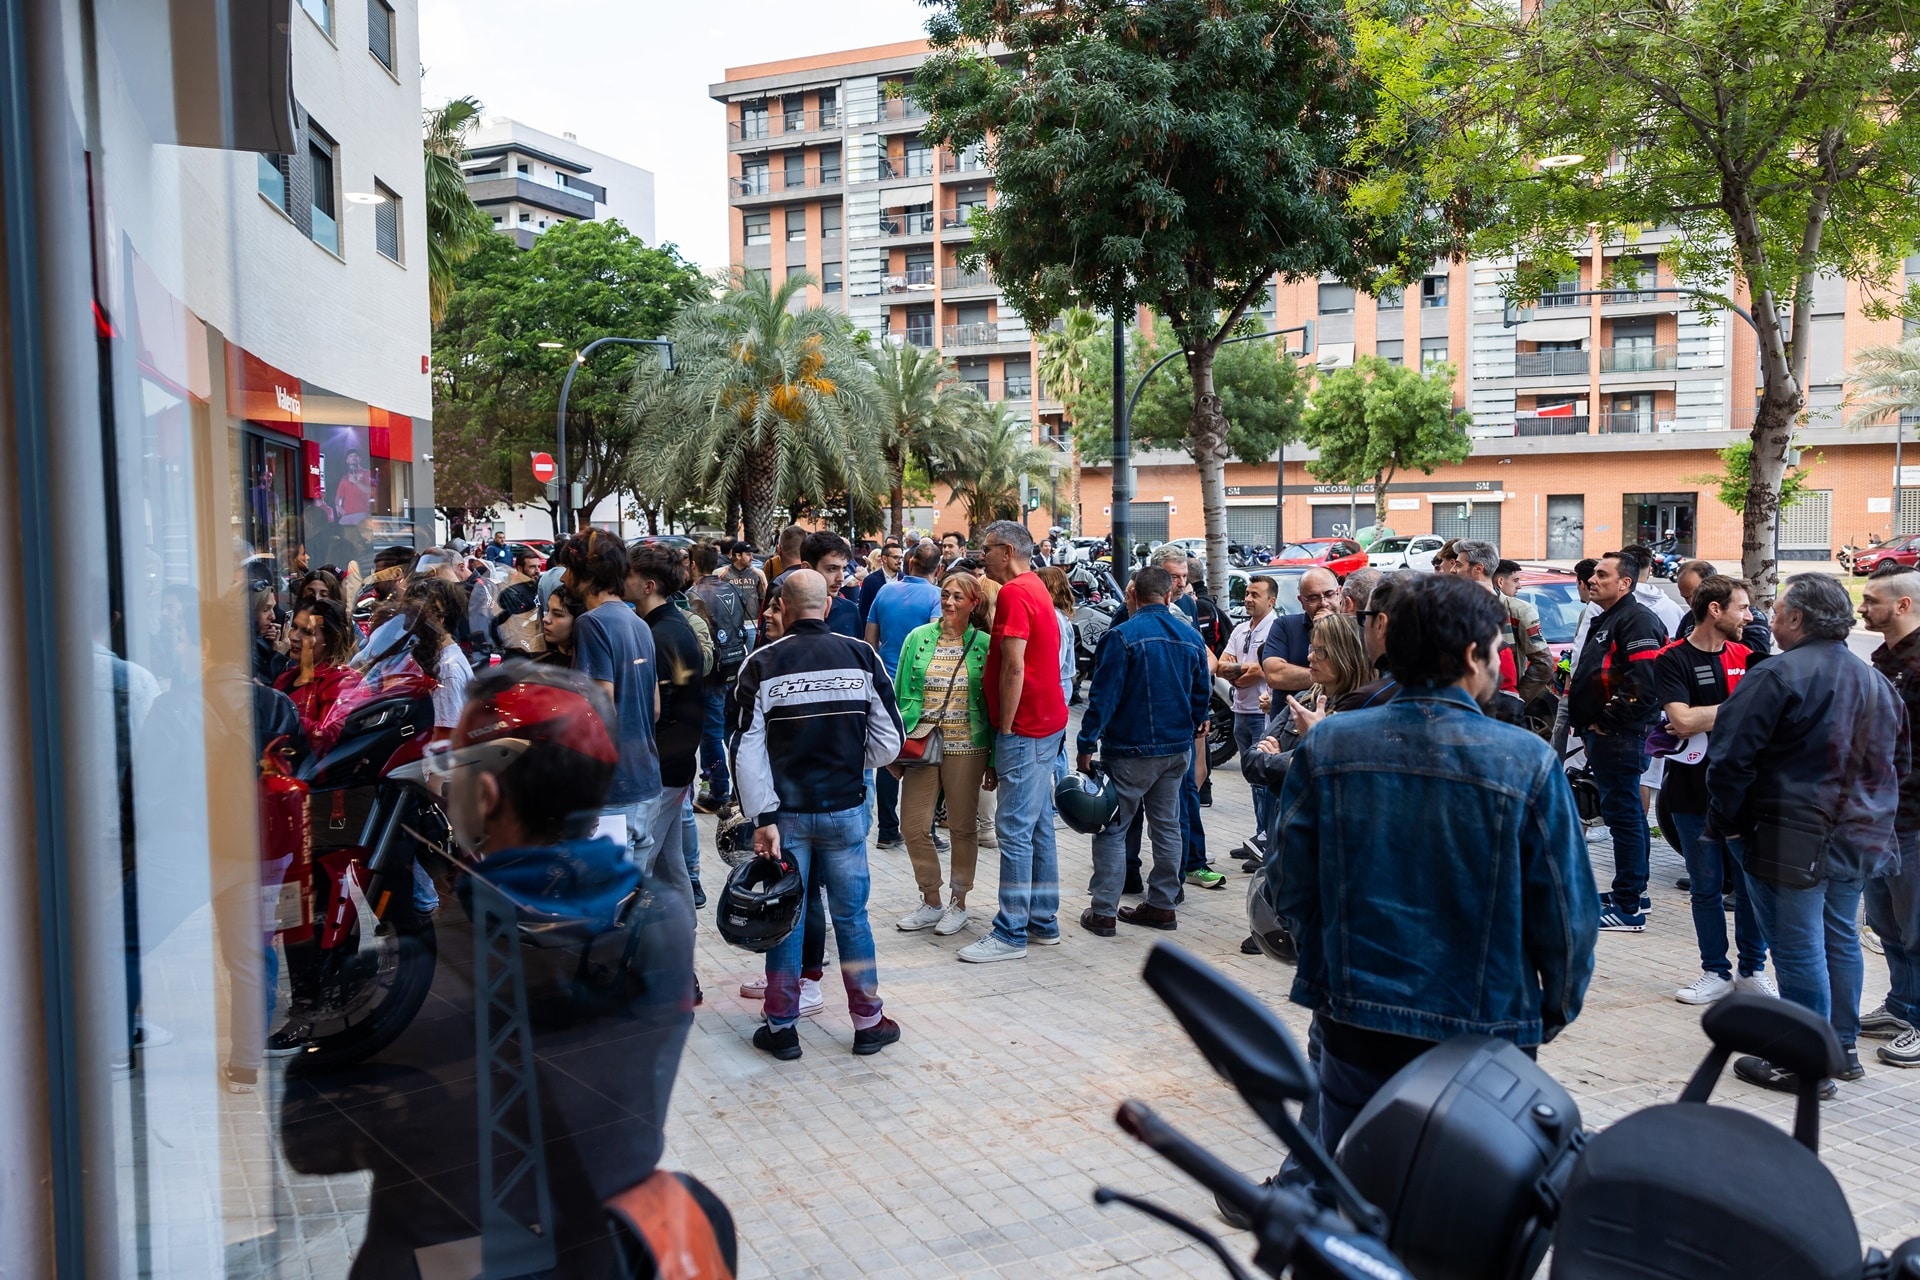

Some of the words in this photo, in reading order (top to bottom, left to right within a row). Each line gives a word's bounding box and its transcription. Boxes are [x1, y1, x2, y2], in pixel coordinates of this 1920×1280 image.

[1476, 481, 1490, 490] SM
[1228, 487, 1240, 495] SM
[768, 677, 864, 698] alpinestars
